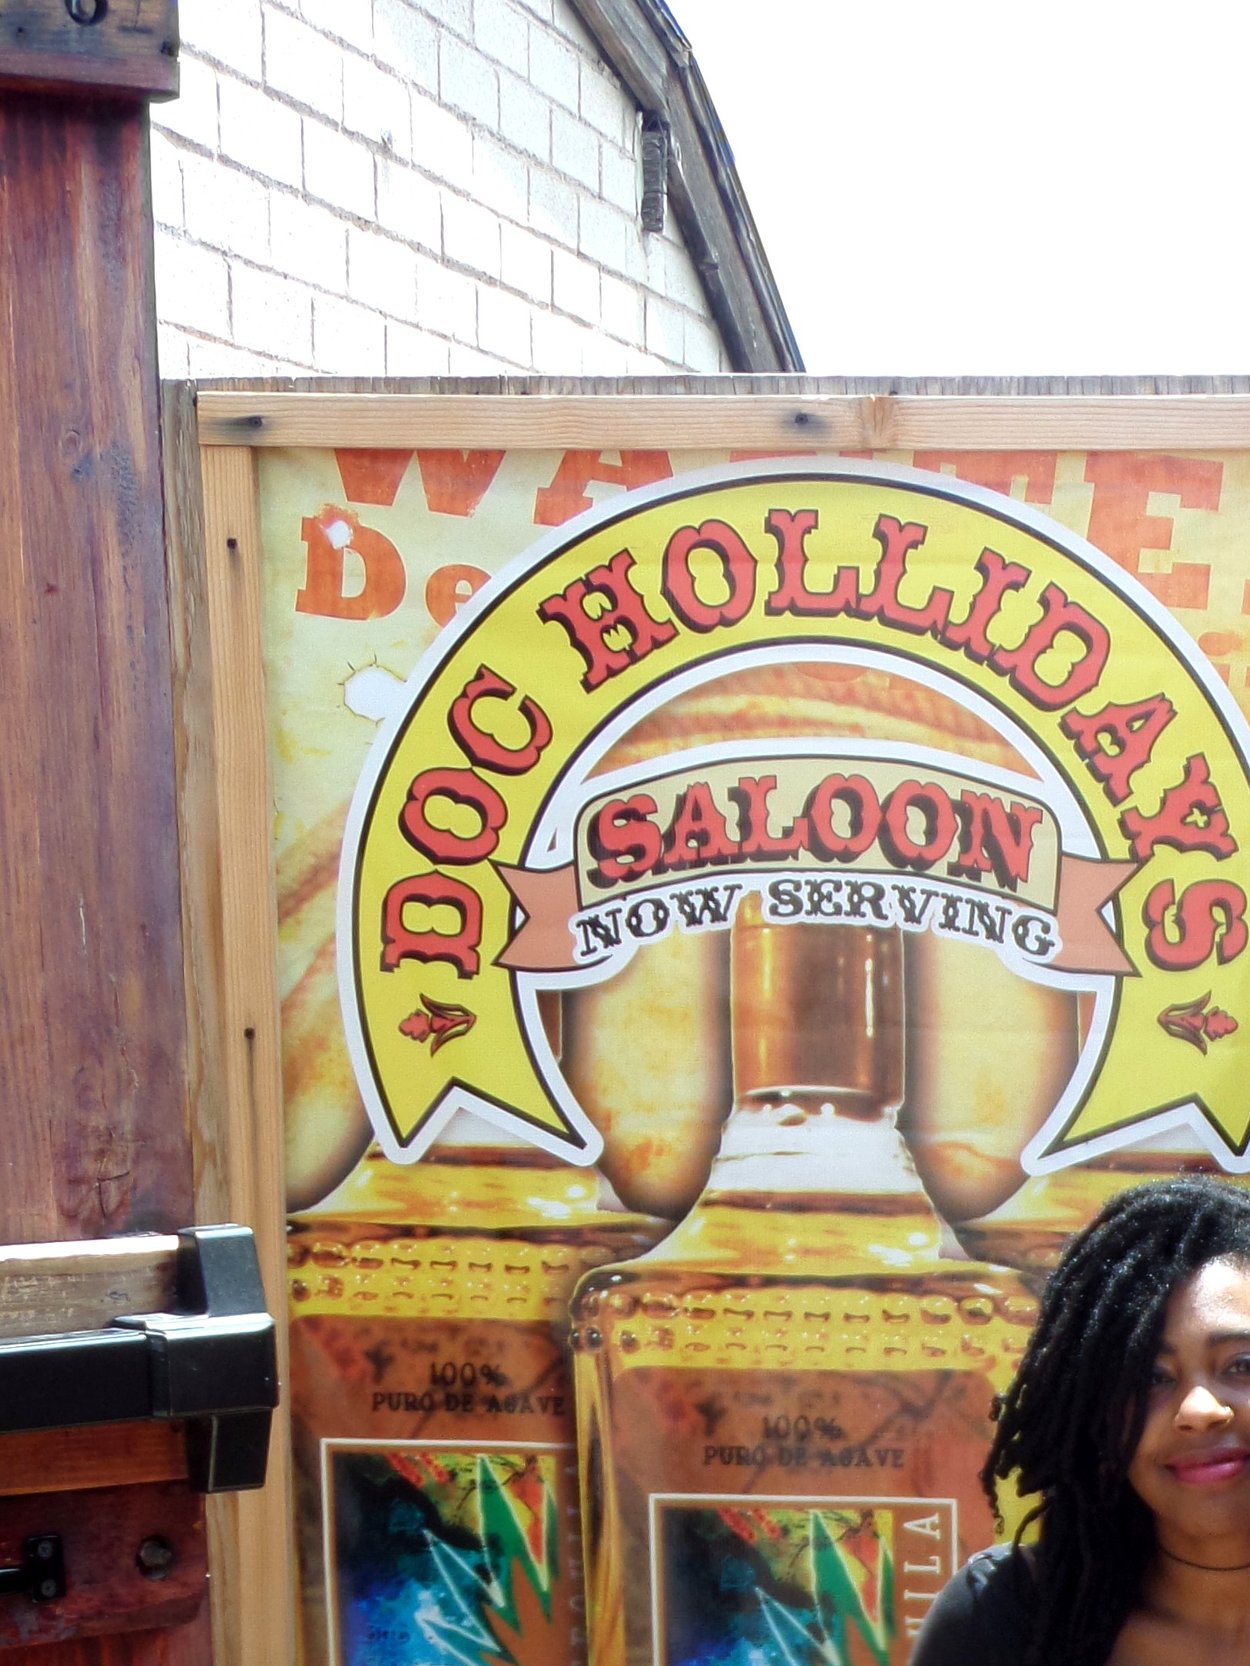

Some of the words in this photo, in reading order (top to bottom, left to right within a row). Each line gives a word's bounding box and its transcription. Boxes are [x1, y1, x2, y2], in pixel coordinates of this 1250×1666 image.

[380, 663, 553, 980] DOC
[535, 508, 1249, 972] HOLLIDAYS
[587, 773, 1043, 894] SALOON
[576, 883, 742, 957] NOW
[768, 878, 1056, 955] SERVING
[372, 1391, 435, 1413] PURO
[444, 1392, 474, 1414] DE
[703, 1444, 767, 1467] PURO
[777, 1446, 808, 1467] DE
